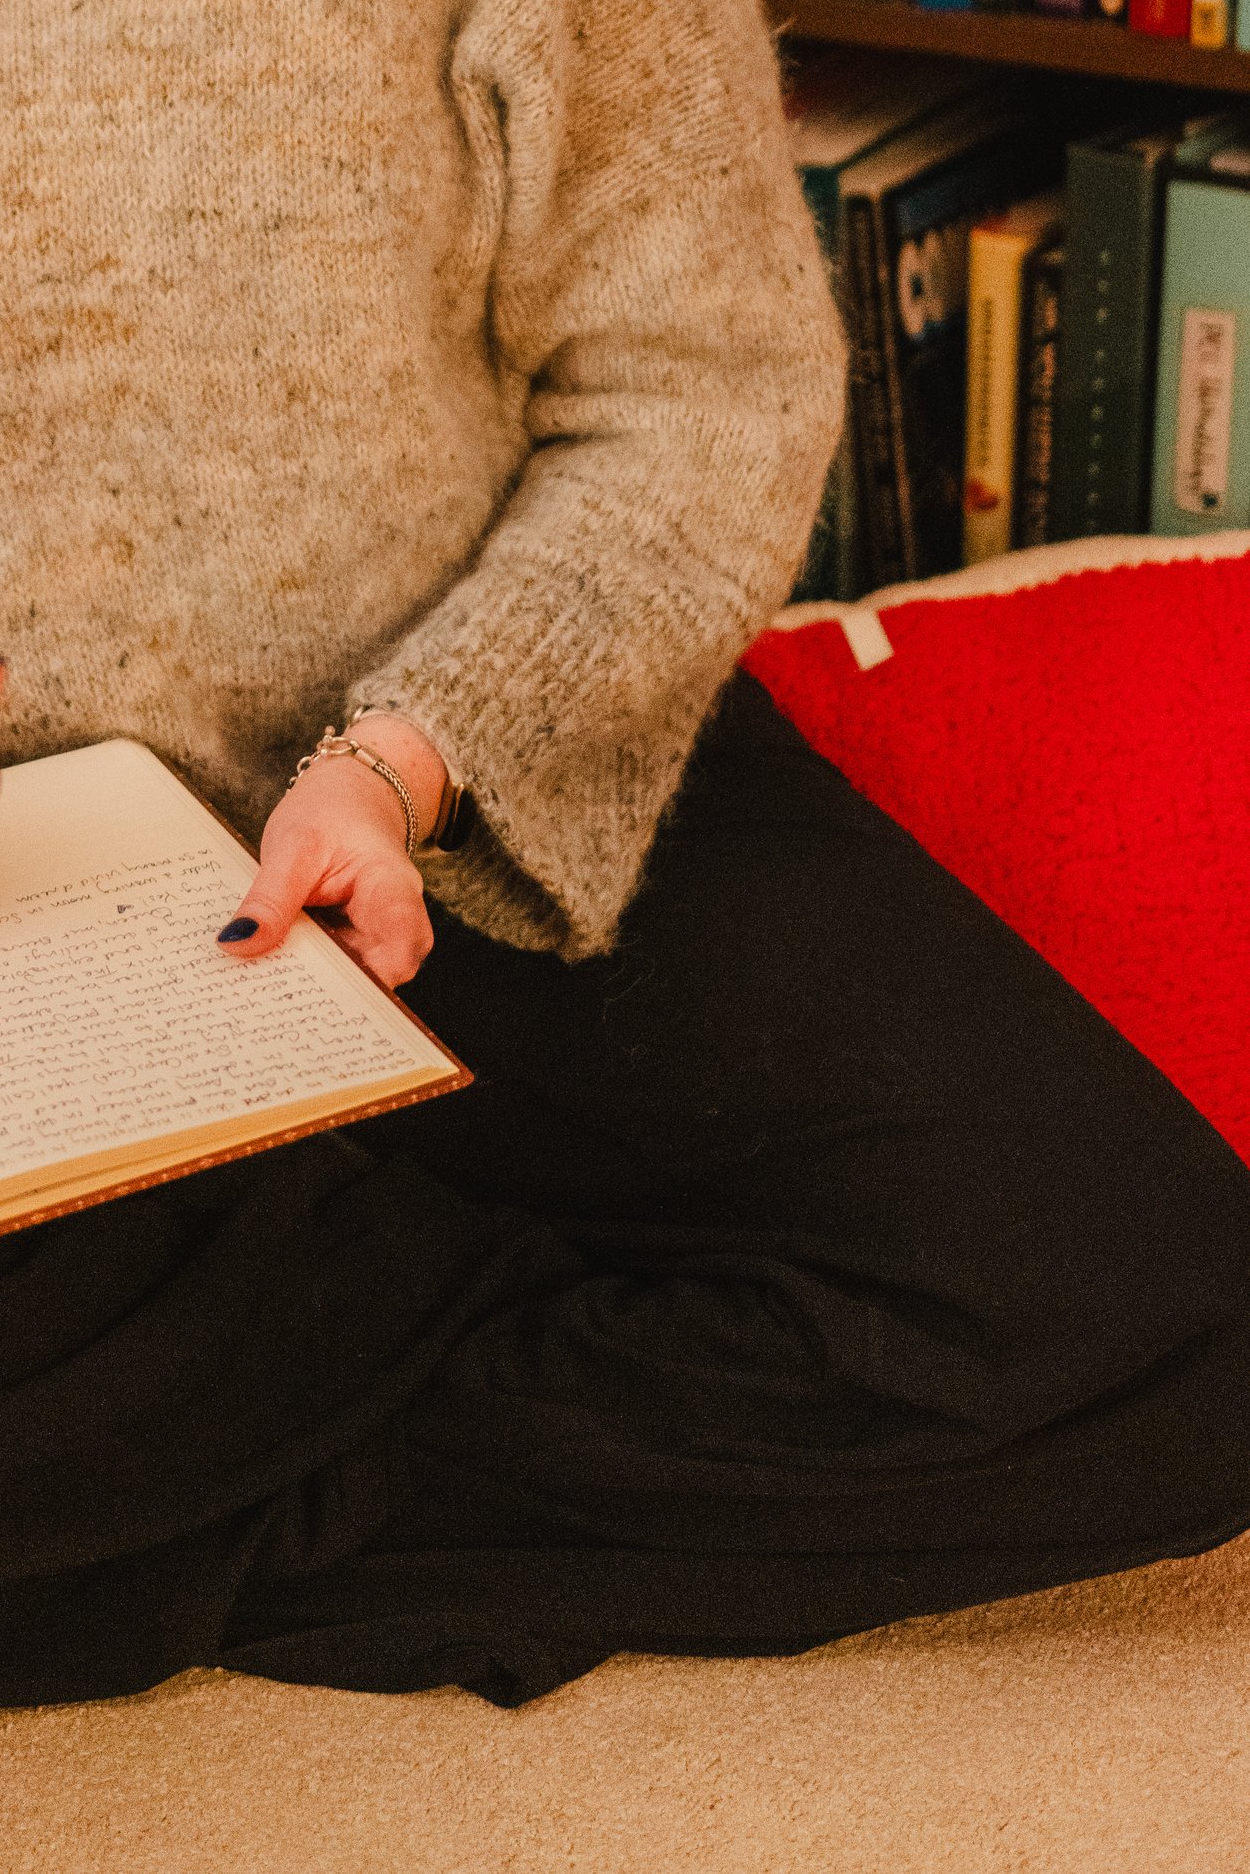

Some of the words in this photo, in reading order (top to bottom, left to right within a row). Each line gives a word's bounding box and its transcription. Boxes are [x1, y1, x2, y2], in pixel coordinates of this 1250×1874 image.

[119, 856, 173, 872] many
[179, 859, 222, 876] Under
[78, 868, 122, 887] vivid
[94, 875, 158, 895] waning
[49, 893, 92, 908] moon
[137, 889, 179, 906] Yes!
[96, 905, 174, 926] Queen,
[23, 938, 99, 963] feelings
[102, 943, 143, 961] and
[22, 967, 78, 986] King
[81, 963, 118, 980] The
[249, 979, 288, 995] offer
[270, 985, 325, 1002] mean
[7, 988, 68, 1006] when
[222, 997, 263, 1014] you
[253, 997, 340, 1020] because
[164, 1010, 215, 1028] need
[319, 1011, 372, 1029] King
[21, 1027, 72, 1043] how
[96, 1028, 173, 1056] grateful
[249, 1029, 301, 1046] Cups
[317, 1031, 365, 1046] may
[204, 1044, 232, 1056] Six
[305, 1045, 365, 1062] much
[7, 1054, 61, 1071] have
[35, 1057, 112, 1079] always
[33, 1096, 81, 1116] need
[94, 1090, 172, 1114] involved
[139, 1095, 198, 1115] process
